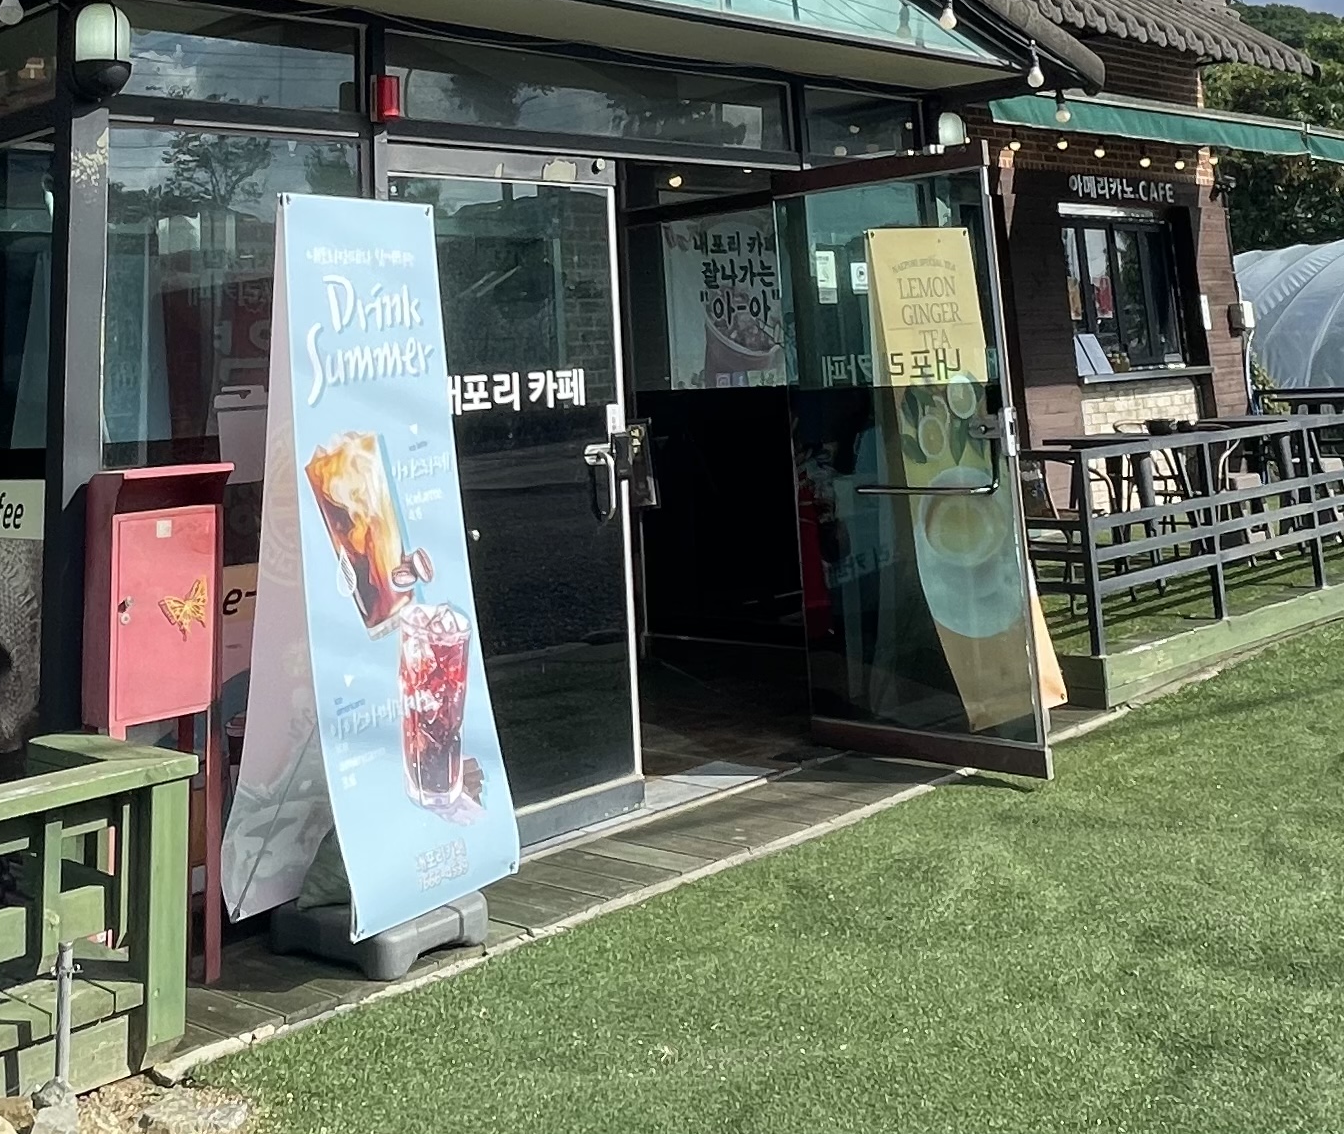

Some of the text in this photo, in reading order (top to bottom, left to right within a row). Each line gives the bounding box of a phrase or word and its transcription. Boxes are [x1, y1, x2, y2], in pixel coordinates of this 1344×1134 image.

[692, 231, 741, 257] 내포리
[701, 259, 775, 290] 잘나가는
[897, 276, 956, 300] LEMON
[322, 274, 424, 333] Drink
[901, 302, 962, 326] GINGER
[918, 328, 952, 352] TEA
[307, 322, 434, 406] Summer
[527, 368, 587, 410] 카페
